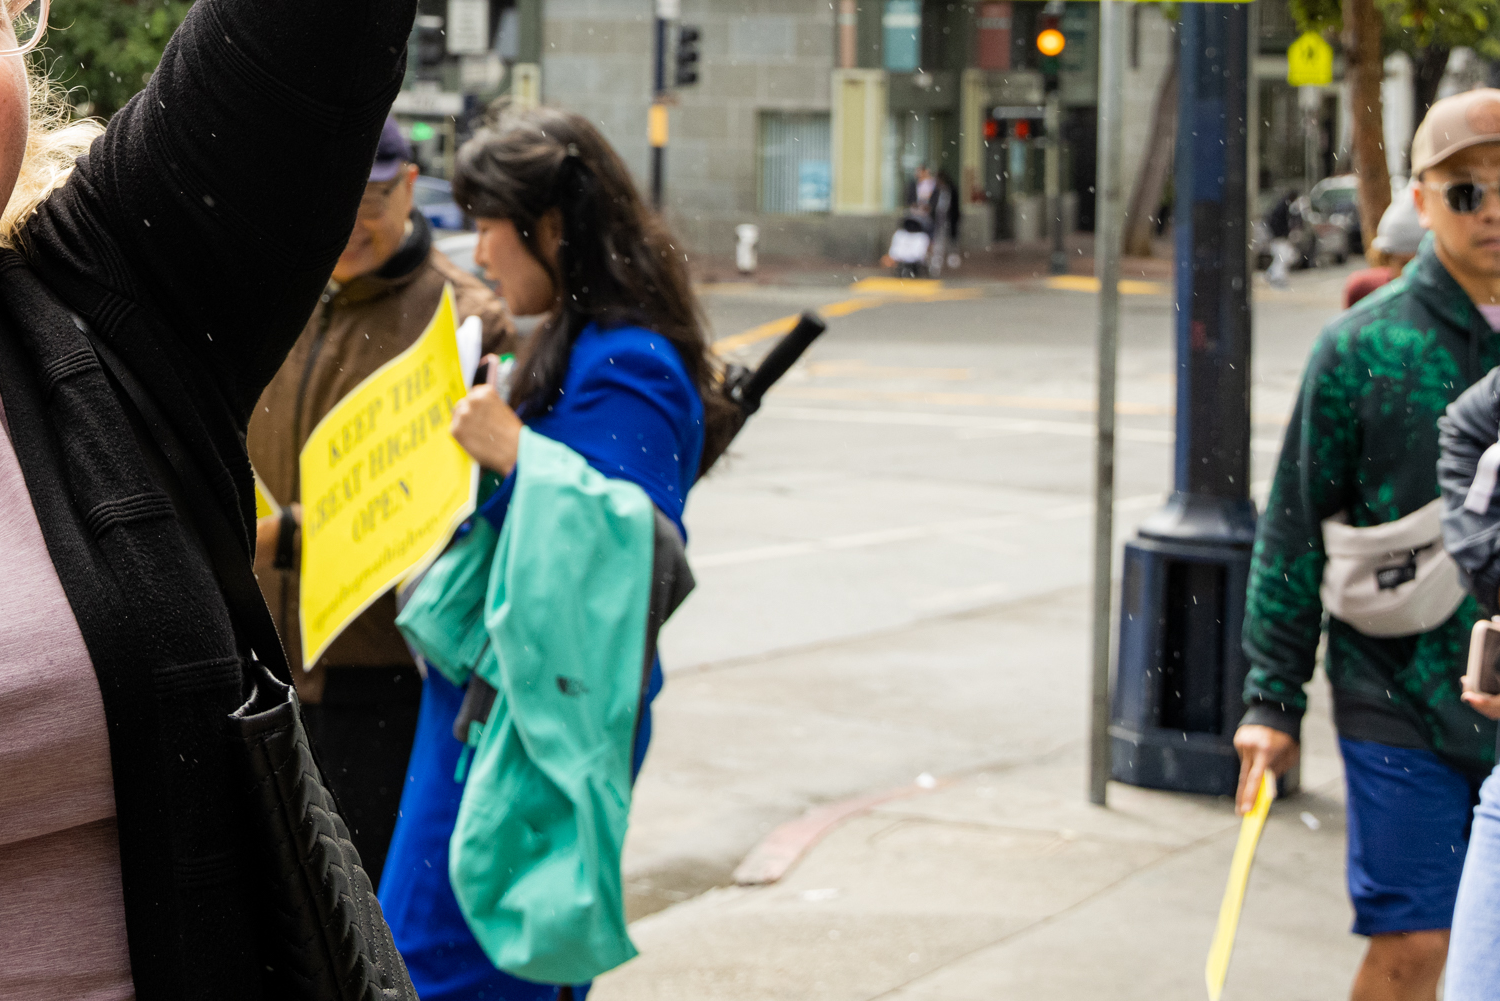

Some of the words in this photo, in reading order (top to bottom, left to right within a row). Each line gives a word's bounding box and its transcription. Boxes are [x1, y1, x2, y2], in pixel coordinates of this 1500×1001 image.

[328, 396, 383, 468] KEEP
[387, 355, 436, 414] THE
[352, 472, 414, 543] OPEN
